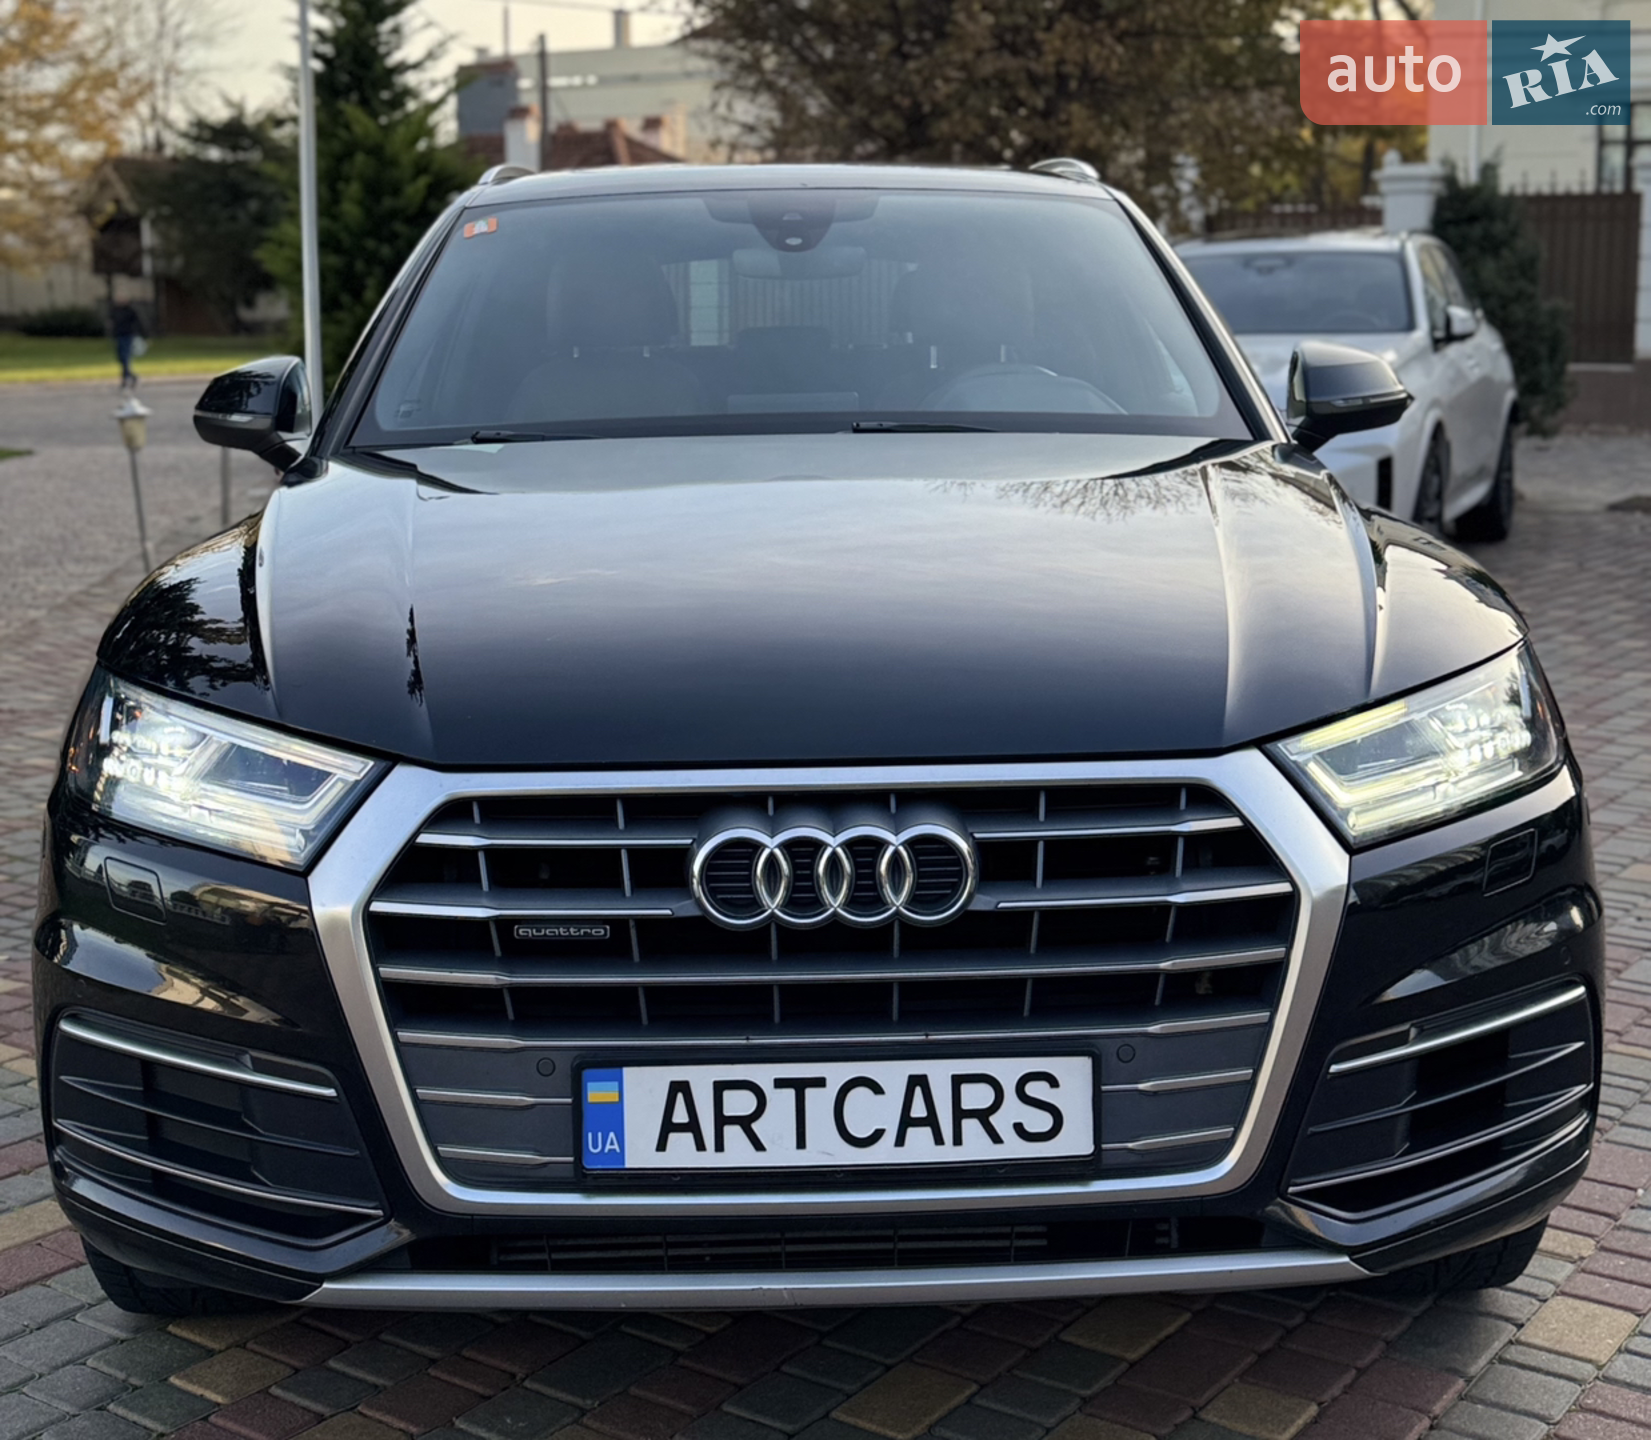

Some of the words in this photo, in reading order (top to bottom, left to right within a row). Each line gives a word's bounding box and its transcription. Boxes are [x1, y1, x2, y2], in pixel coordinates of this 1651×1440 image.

[518, 927, 605, 938] quattro
[655, 1071, 1065, 1153] ARTCARS
[587, 1132, 620, 1154] UA
